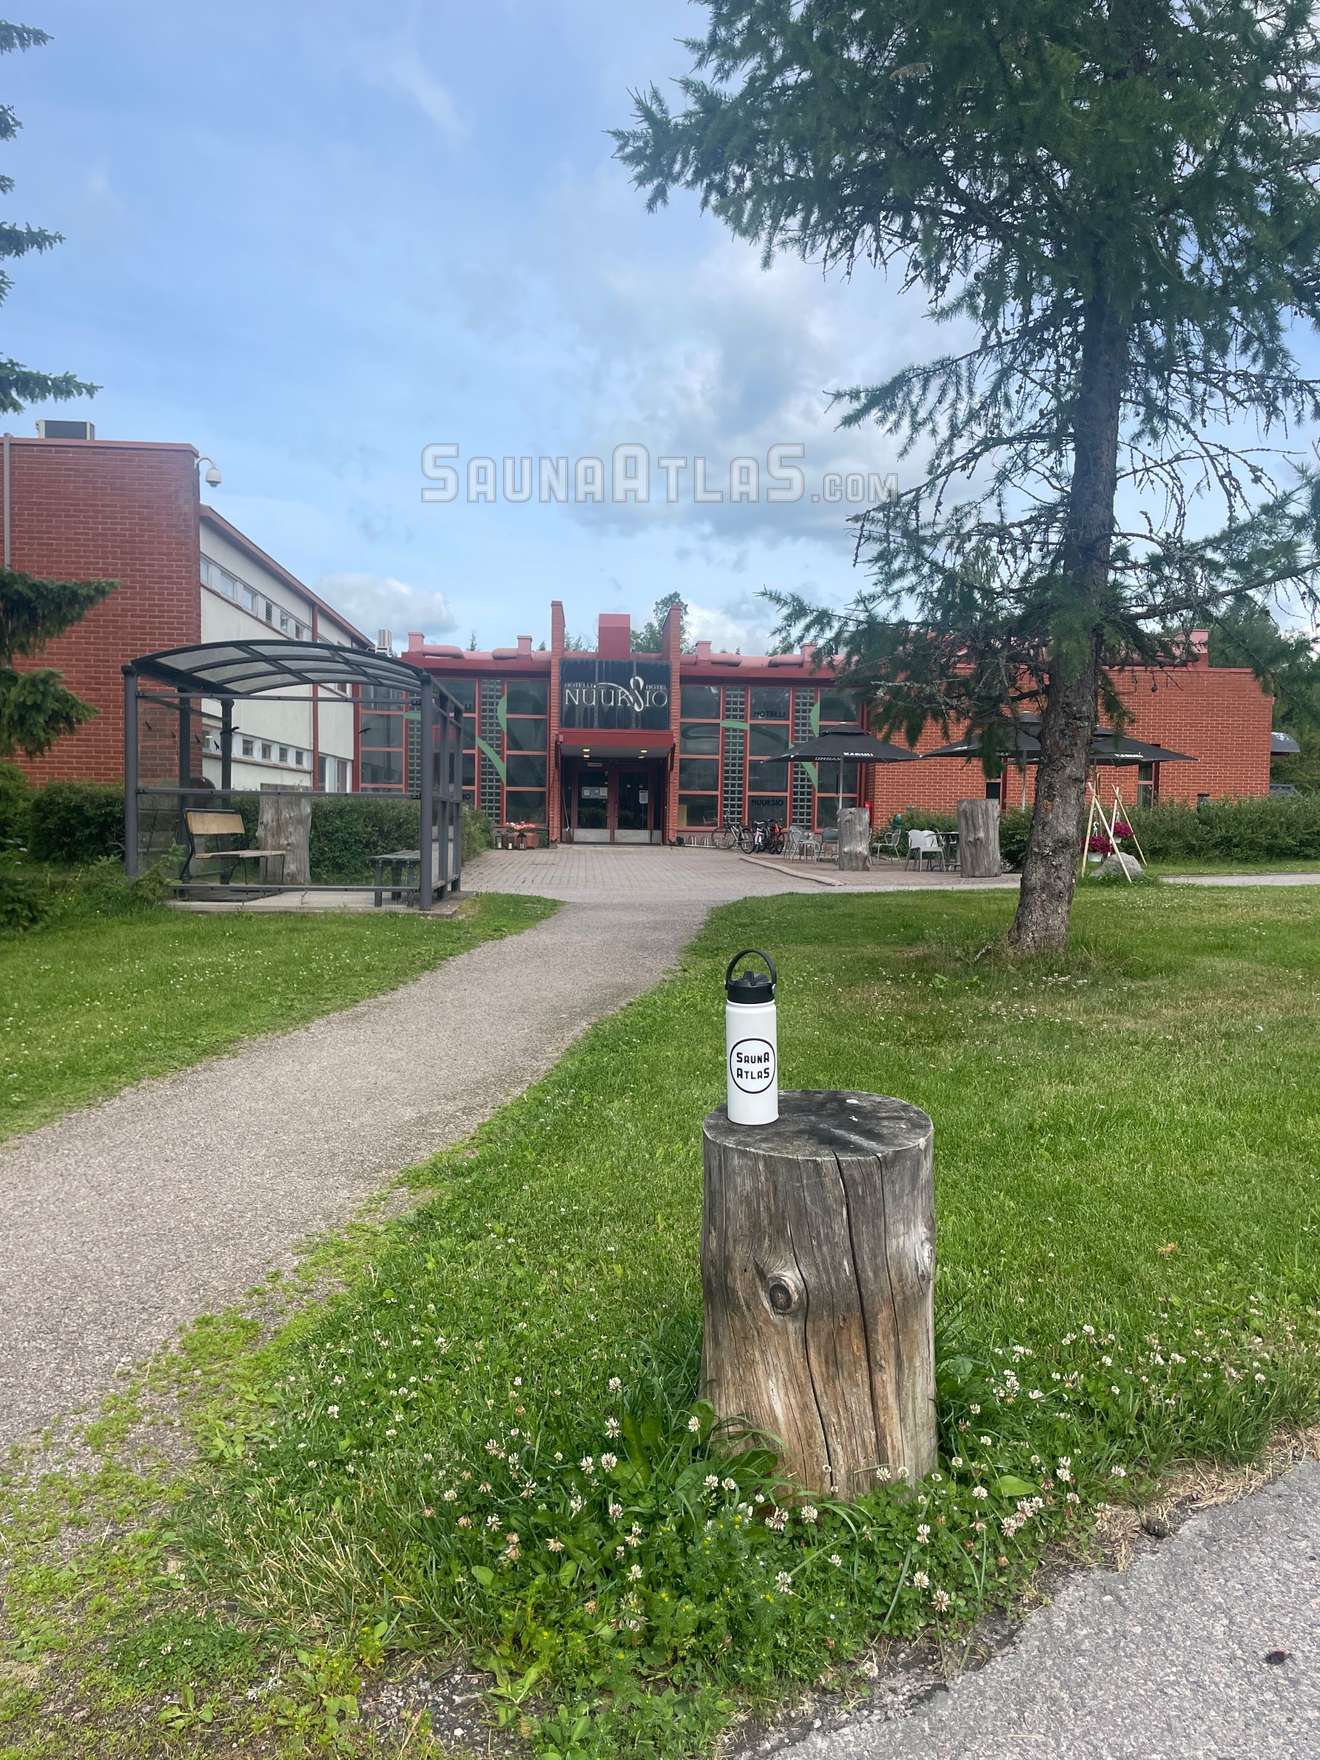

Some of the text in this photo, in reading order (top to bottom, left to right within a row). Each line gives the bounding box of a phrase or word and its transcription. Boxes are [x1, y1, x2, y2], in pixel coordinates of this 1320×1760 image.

[565, 676, 667, 711] NUUKSIO
[736, 1052, 769, 1063] SAUNA
[736, 1068, 769, 1079] ATLAS
